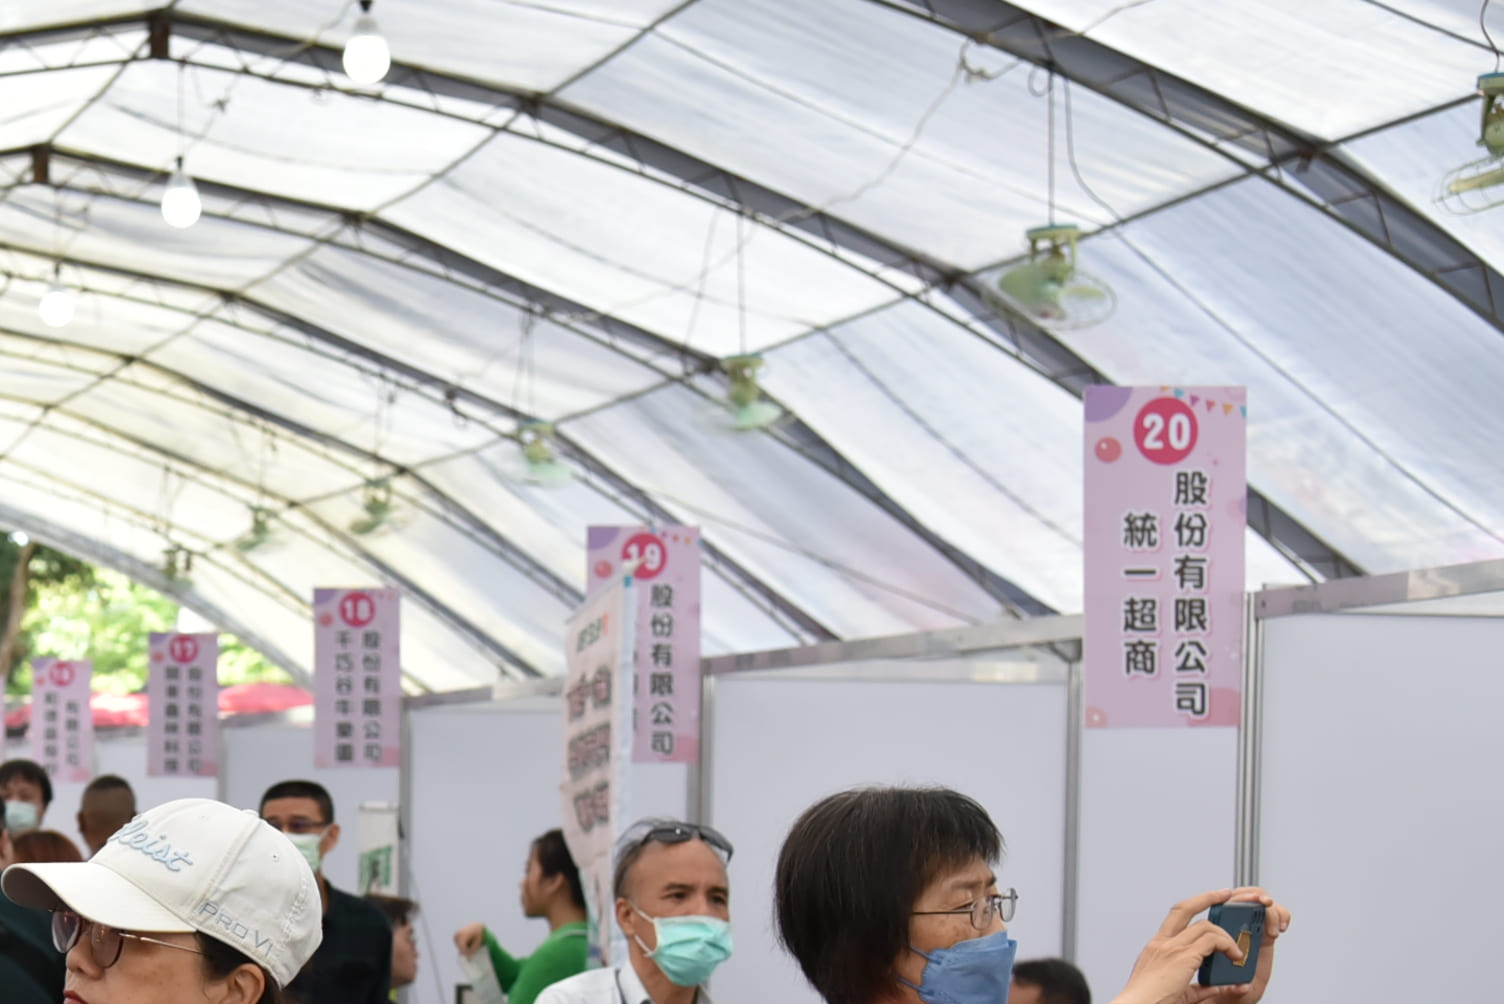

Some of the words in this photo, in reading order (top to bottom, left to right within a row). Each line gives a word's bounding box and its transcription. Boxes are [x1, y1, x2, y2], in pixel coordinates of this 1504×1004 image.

[1142, 412, 1191, 450] 20
[650, 584, 674, 755] 股份有限公司
[1123, 512, 1157, 675] 統一超商
[1174, 471, 1207, 716] 股份有限公司
[199, 902, 249, 939] PRO
